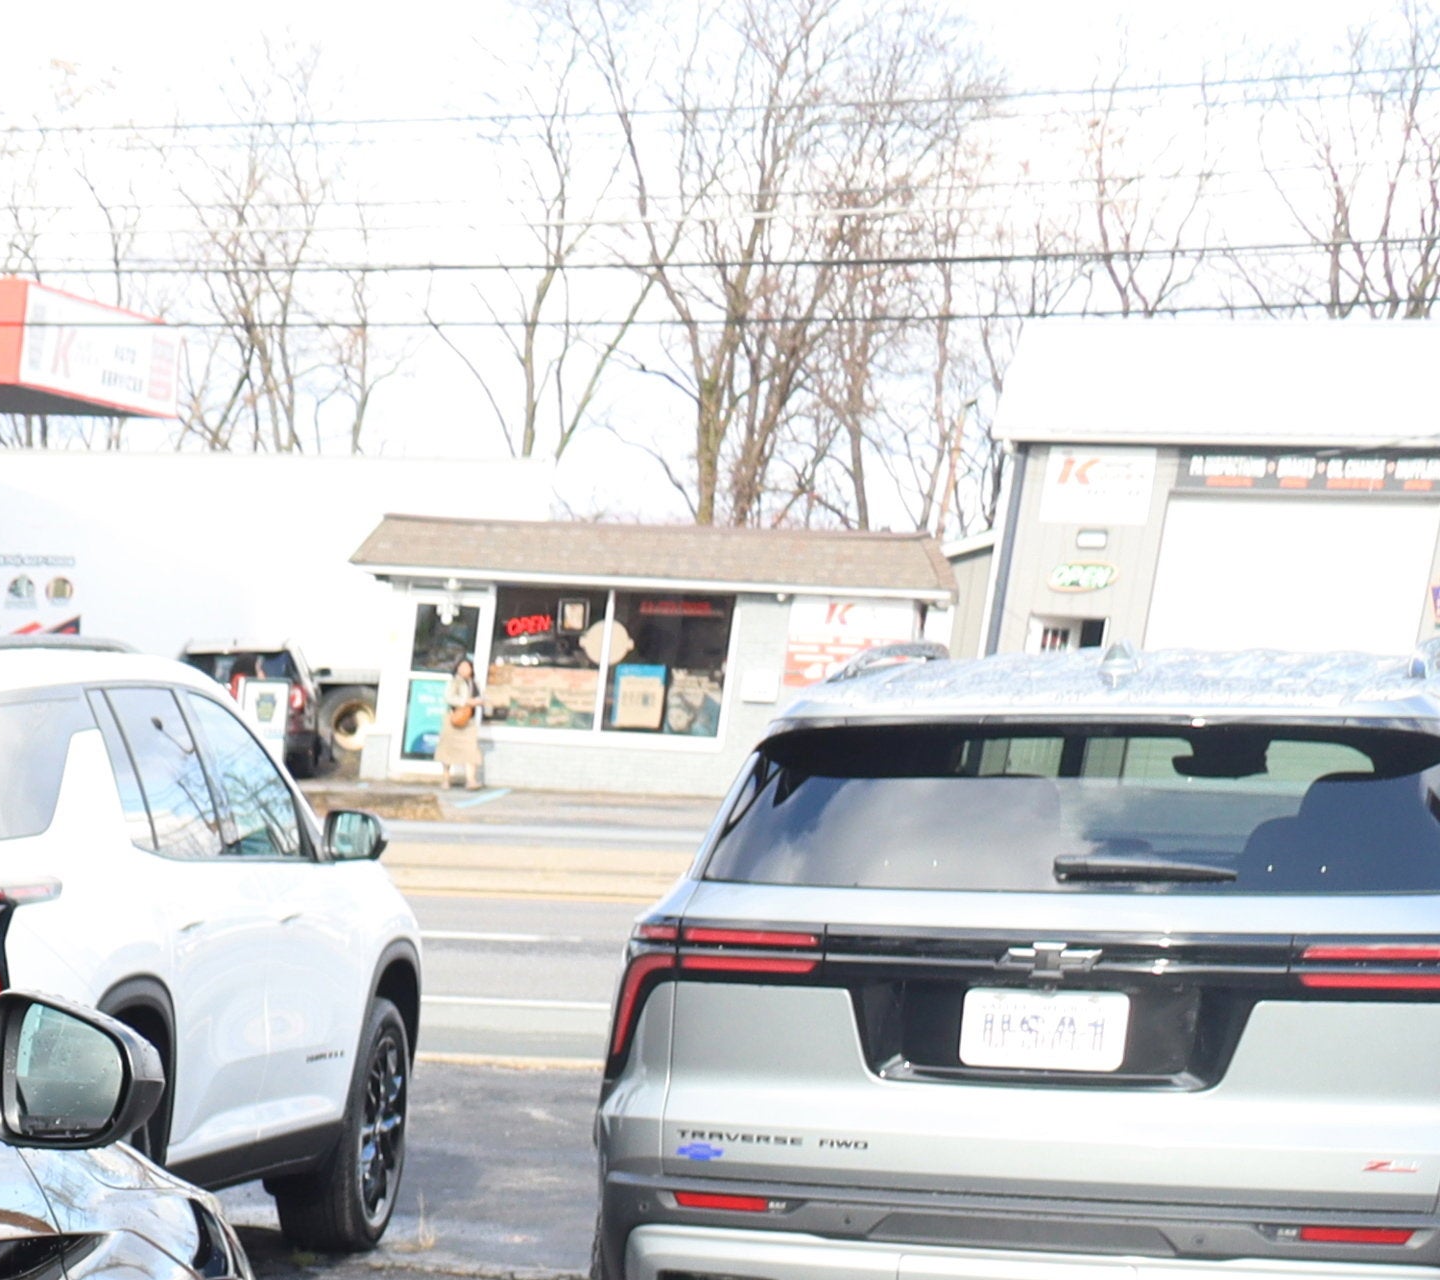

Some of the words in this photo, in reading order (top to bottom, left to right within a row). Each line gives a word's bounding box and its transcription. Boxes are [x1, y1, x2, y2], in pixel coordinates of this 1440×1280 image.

[1050, 563, 1114, 589] OPEN
[504, 614, 552, 637] OPEN
[678, 1129, 803, 1146] TRAVERSE
